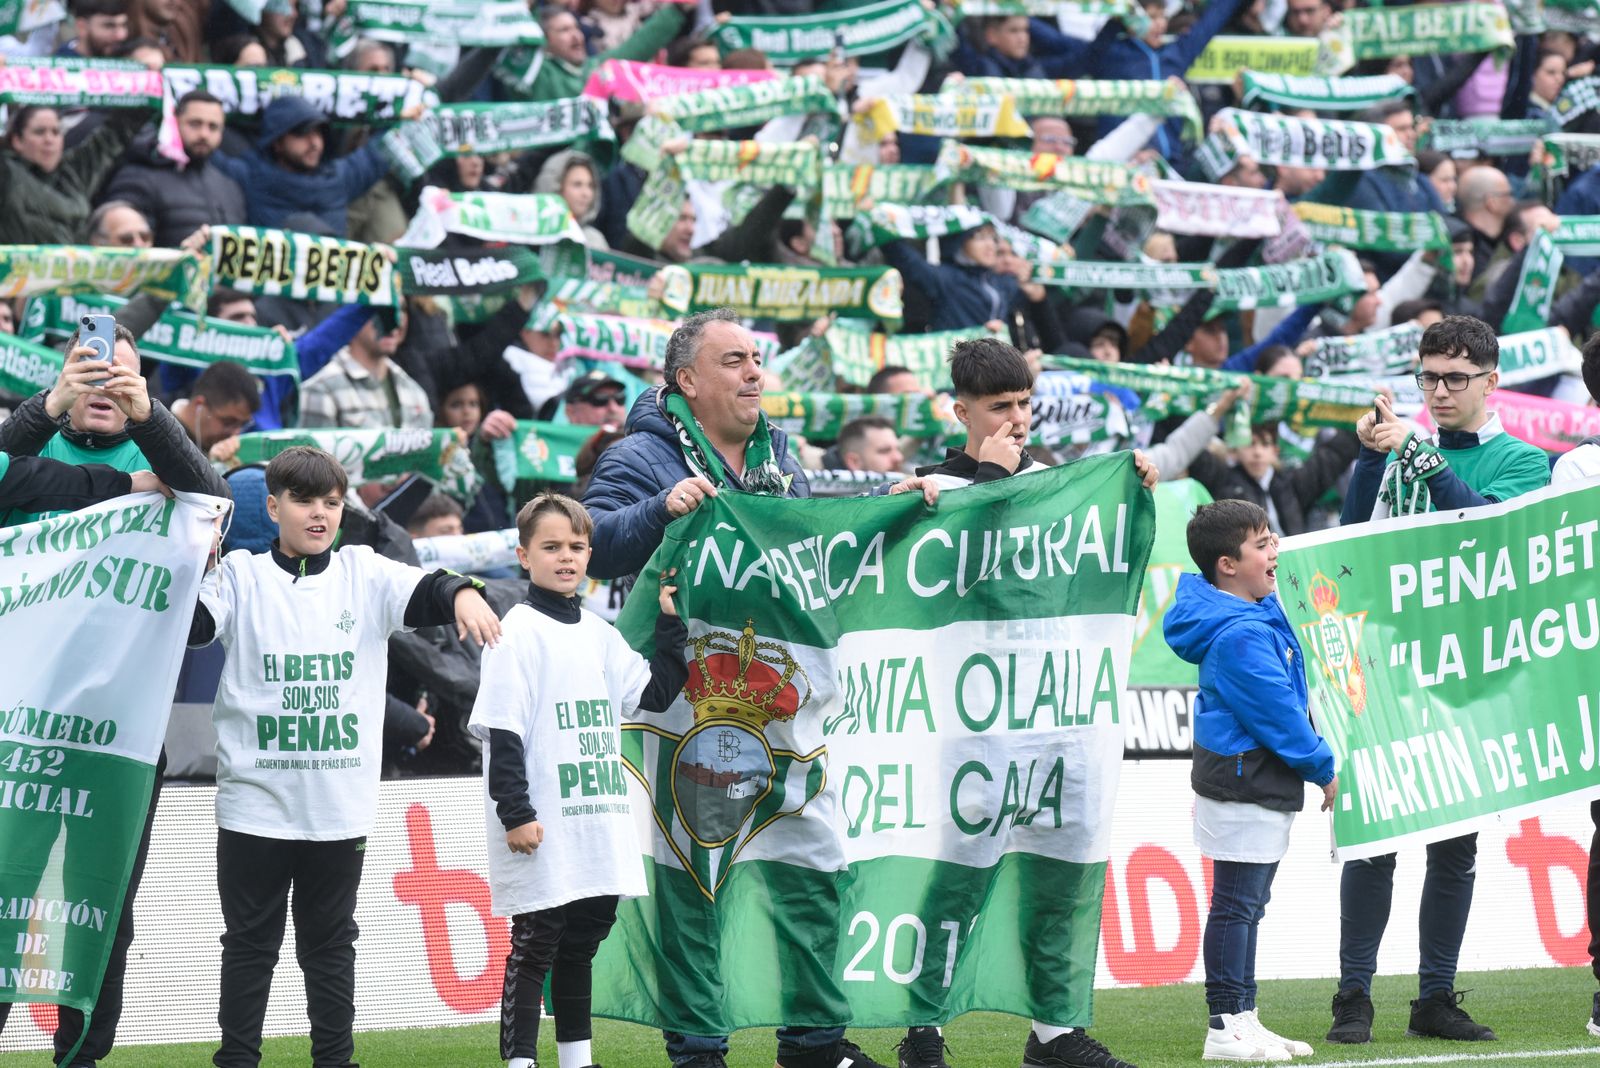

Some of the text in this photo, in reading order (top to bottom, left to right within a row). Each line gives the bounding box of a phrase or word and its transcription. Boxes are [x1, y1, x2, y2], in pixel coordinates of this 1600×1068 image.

[217, 236, 291, 282] REAL
[304, 245, 385, 291] BETIS
[410, 256, 519, 287] Real Betis
[695, 273, 865, 306] JUAN MIRANDA
[177, 324, 284, 362] Balompié
[687, 522, 780, 599] ÑA
[1390, 511, 1600, 613] PEÑA BÉT
[84, 555, 173, 613] SUR
[1483, 598, 1600, 675] LAGU
[263, 651, 355, 682] EL BETIS
[282, 685, 339, 710] SON SUS
[955, 647, 1120, 733] OLALLA
[257, 707, 359, 752] PEÑAS
[556, 702, 574, 730] EL
[1124, 690, 1194, 751] ANC
[1, 746, 66, 778] 452
[255, 756, 361, 770] ENCUENTRO ANUAL DE PEÑAS BÉTICAS
[579, 732, 601, 756] SON
[1353, 708, 1482, 826] MARTÍN
[1482, 733, 1528, 793] DE
[1528, 723, 1570, 782] LA
[1578, 694, 1600, 772] J
[842, 756, 1064, 839] DEL CALA
[14, 932, 50, 956] DE
[843, 911, 979, 988] 201
